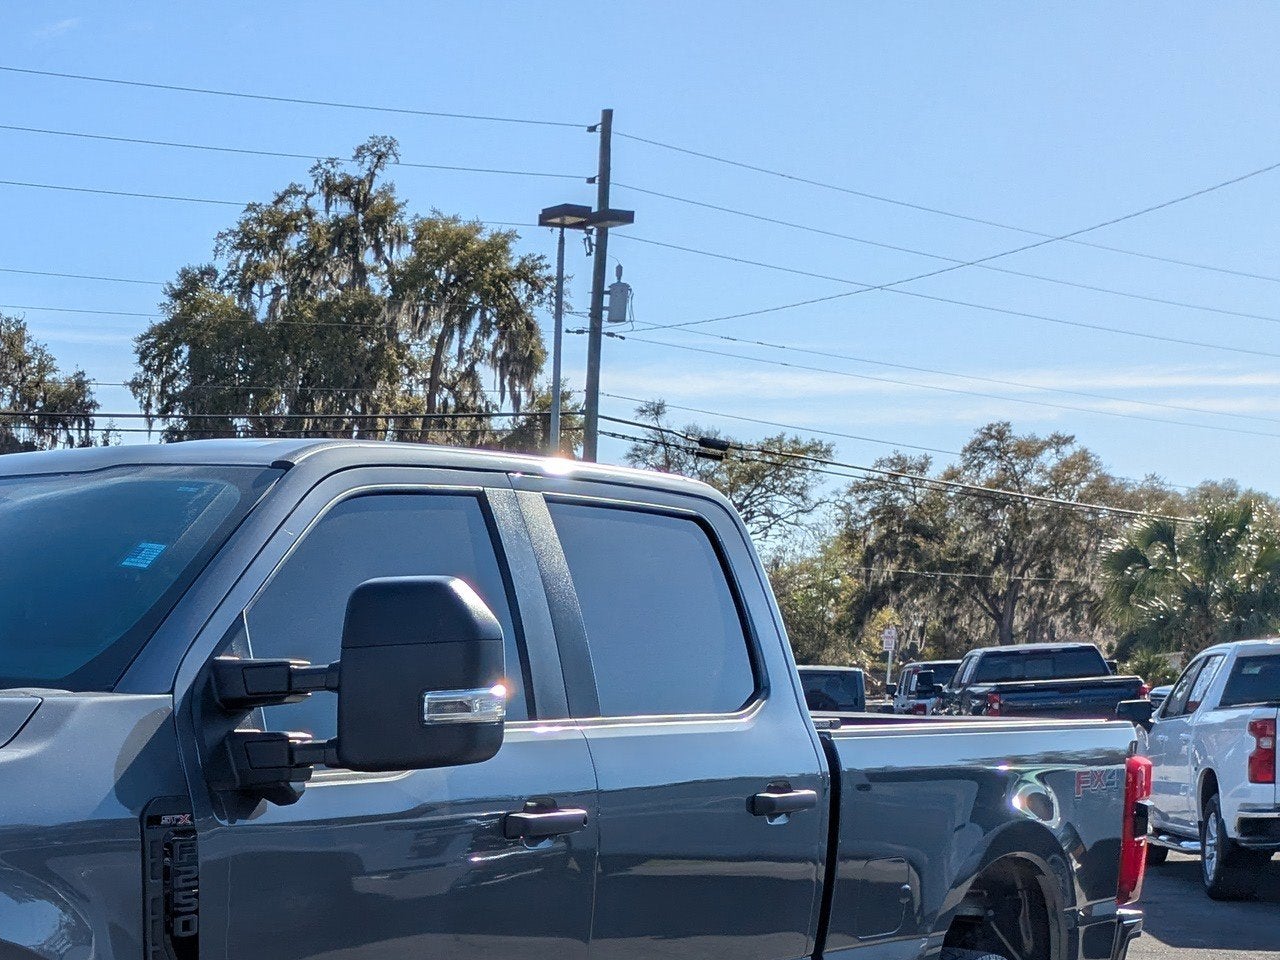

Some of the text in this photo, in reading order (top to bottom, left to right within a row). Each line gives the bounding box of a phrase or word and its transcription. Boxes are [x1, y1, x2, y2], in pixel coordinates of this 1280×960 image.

[1074, 769, 1119, 800] FX4
[160, 813, 192, 825] STX
[173, 840, 199, 938] F250
